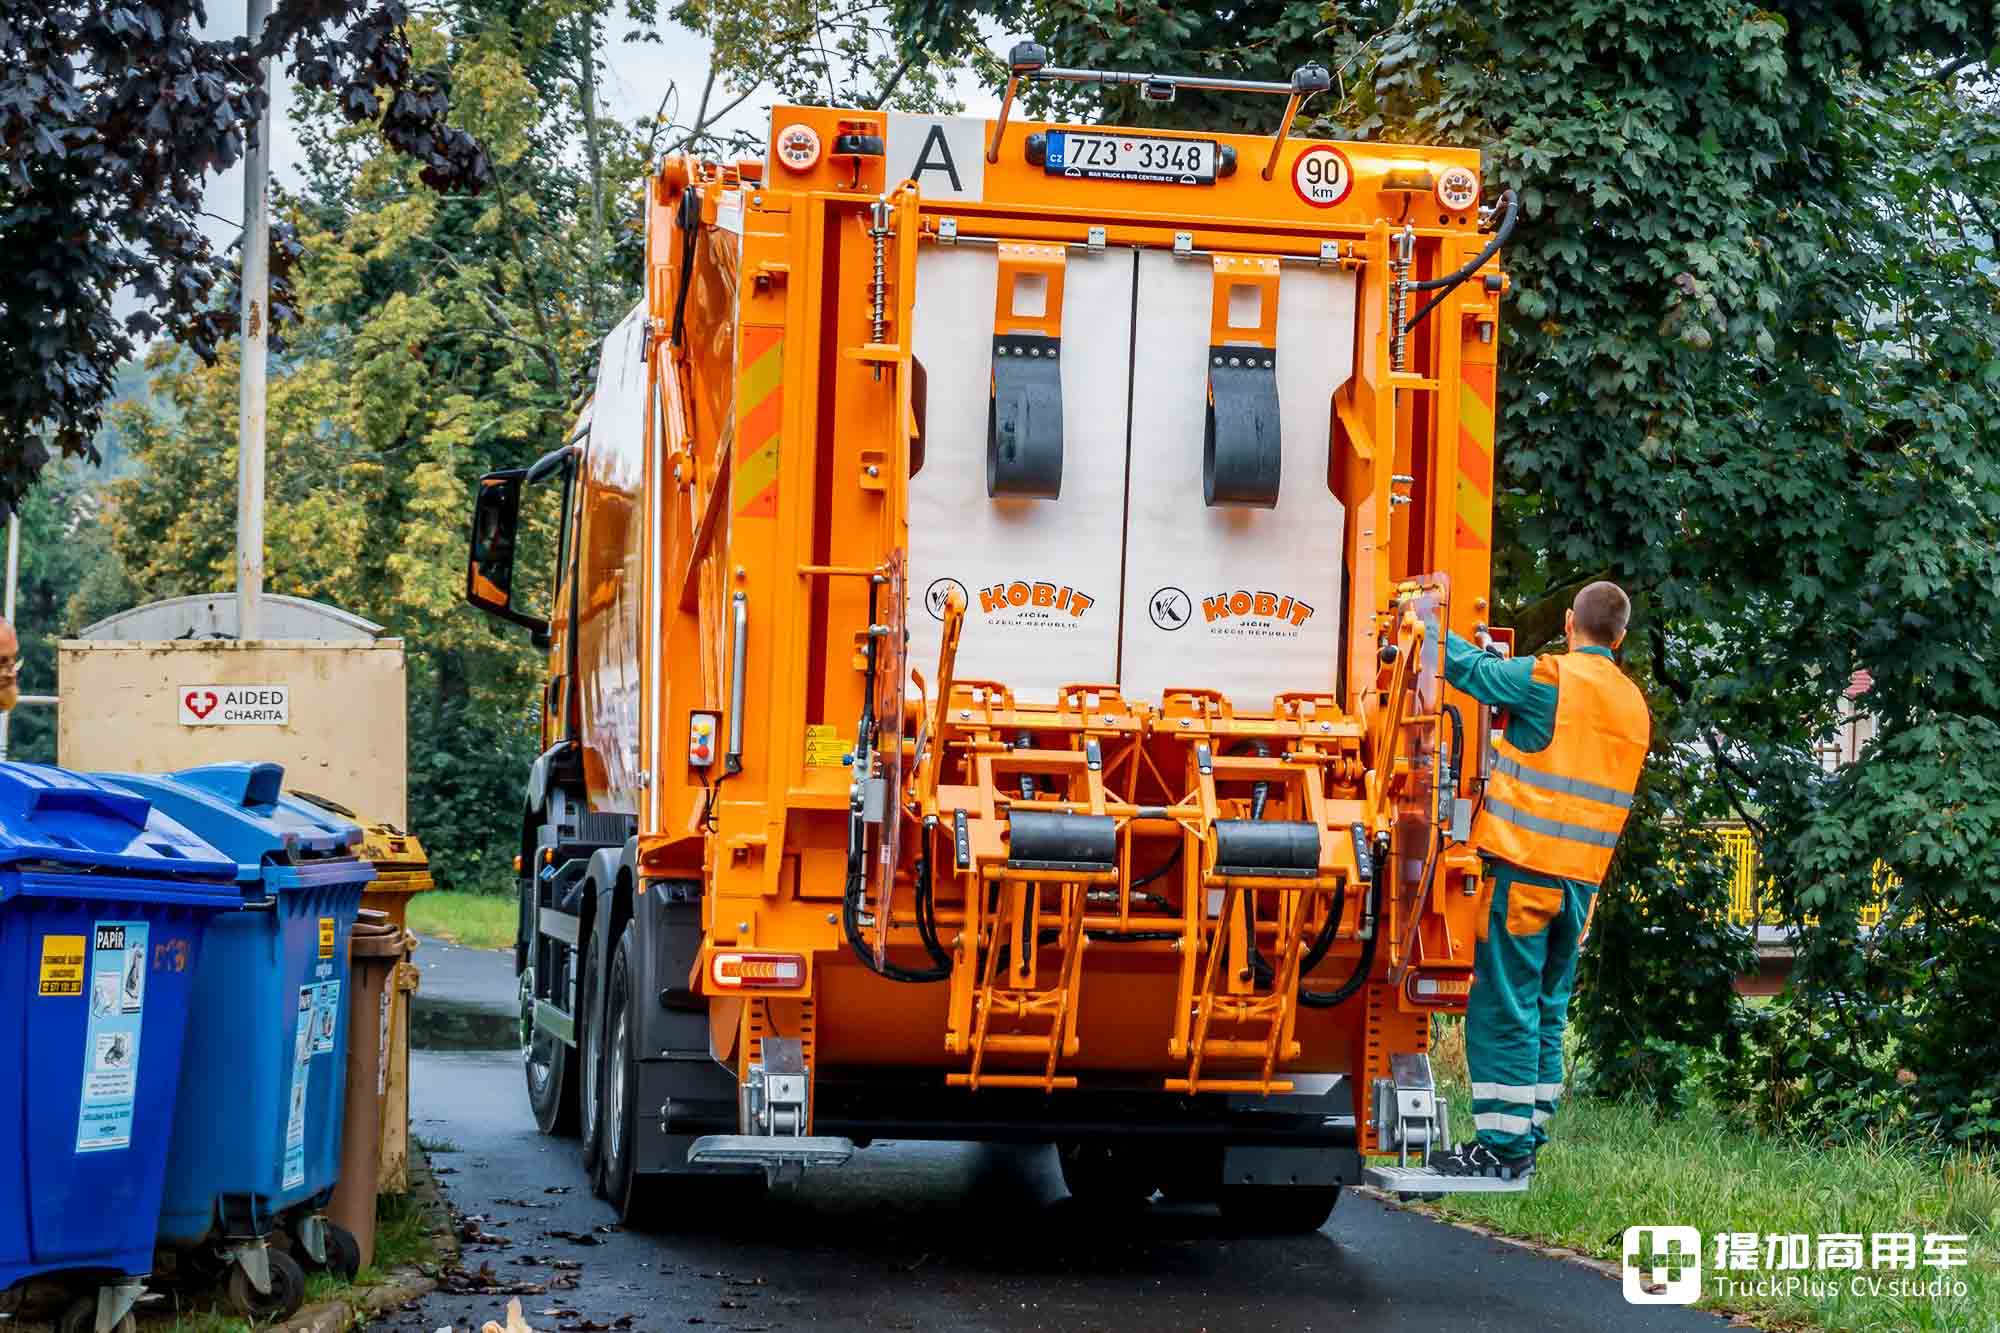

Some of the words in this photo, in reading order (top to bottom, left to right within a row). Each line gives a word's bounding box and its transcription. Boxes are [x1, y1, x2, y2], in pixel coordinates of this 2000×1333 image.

[910, 124, 963, 192] A
[1050, 154, 1063, 163] CZ
[1070, 138, 1117, 166] 7Z3
[1138, 143, 1201, 171] 3348
[1306, 158, 1339, 185] 90
[1312, 185, 1333, 198] km
[978, 581, 1095, 618] KOBIT
[1201, 590, 1315, 626] KOBIT
[1026, 620, 1078, 629] REPUBLIC
[1249, 629, 1298, 637] REPUBLIC
[225, 691, 284, 705] AIDED
[224, 710, 283, 720] CHARITA
[97, 927, 124, 949] PAPÍR
